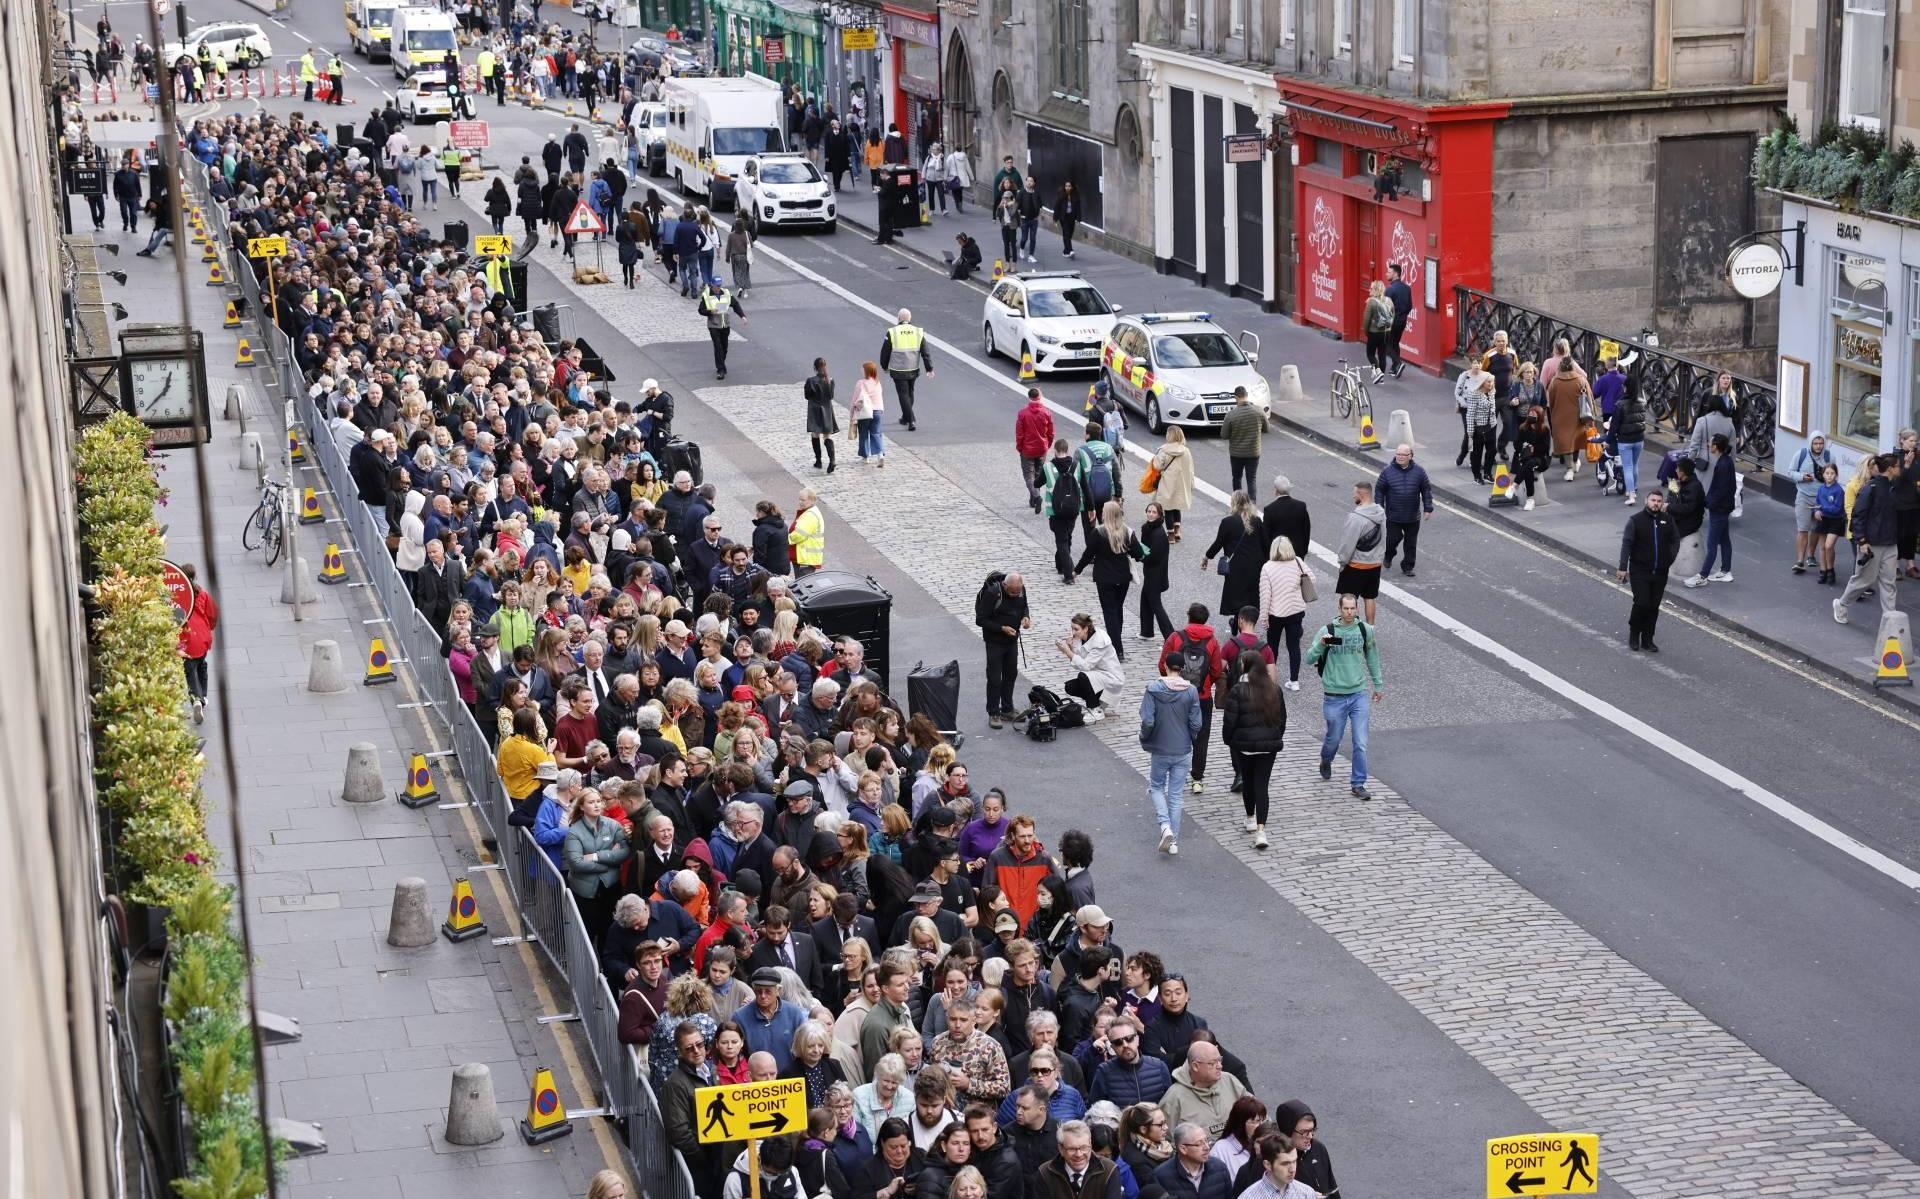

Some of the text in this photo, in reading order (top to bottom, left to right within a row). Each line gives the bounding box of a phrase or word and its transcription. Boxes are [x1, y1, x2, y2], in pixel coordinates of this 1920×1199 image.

[1319, 259, 1330, 275] the
[1735, 264, 1780, 276] VITTORIA
[1311, 269, 1337, 291] elephant
[1212, 406, 1229, 414] EX64
[731, 1082, 803, 1102] CROSSING
[748, 1098, 788, 1114] POINT
[1490, 1140, 1562, 1156] CROSSING
[1505, 1156, 1545, 1170] POINT
